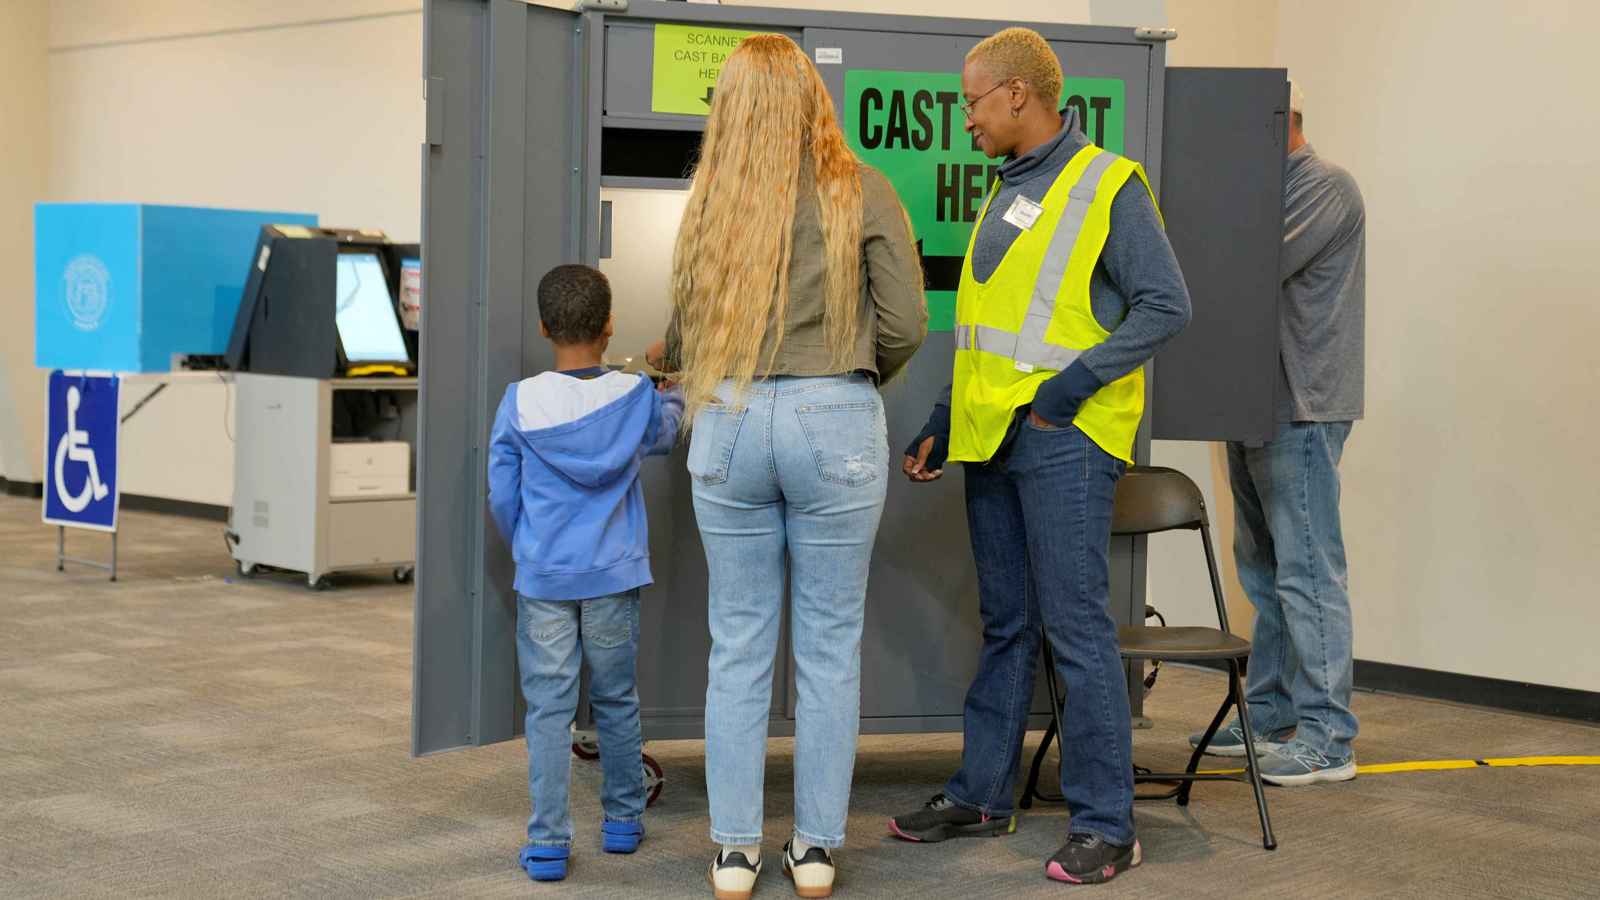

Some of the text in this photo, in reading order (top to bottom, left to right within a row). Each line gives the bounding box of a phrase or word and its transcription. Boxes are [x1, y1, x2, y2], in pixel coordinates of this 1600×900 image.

[687, 33, 744, 47] SCANNE
[674, 49, 709, 62] CAST
[860, 88, 958, 151] CAST
